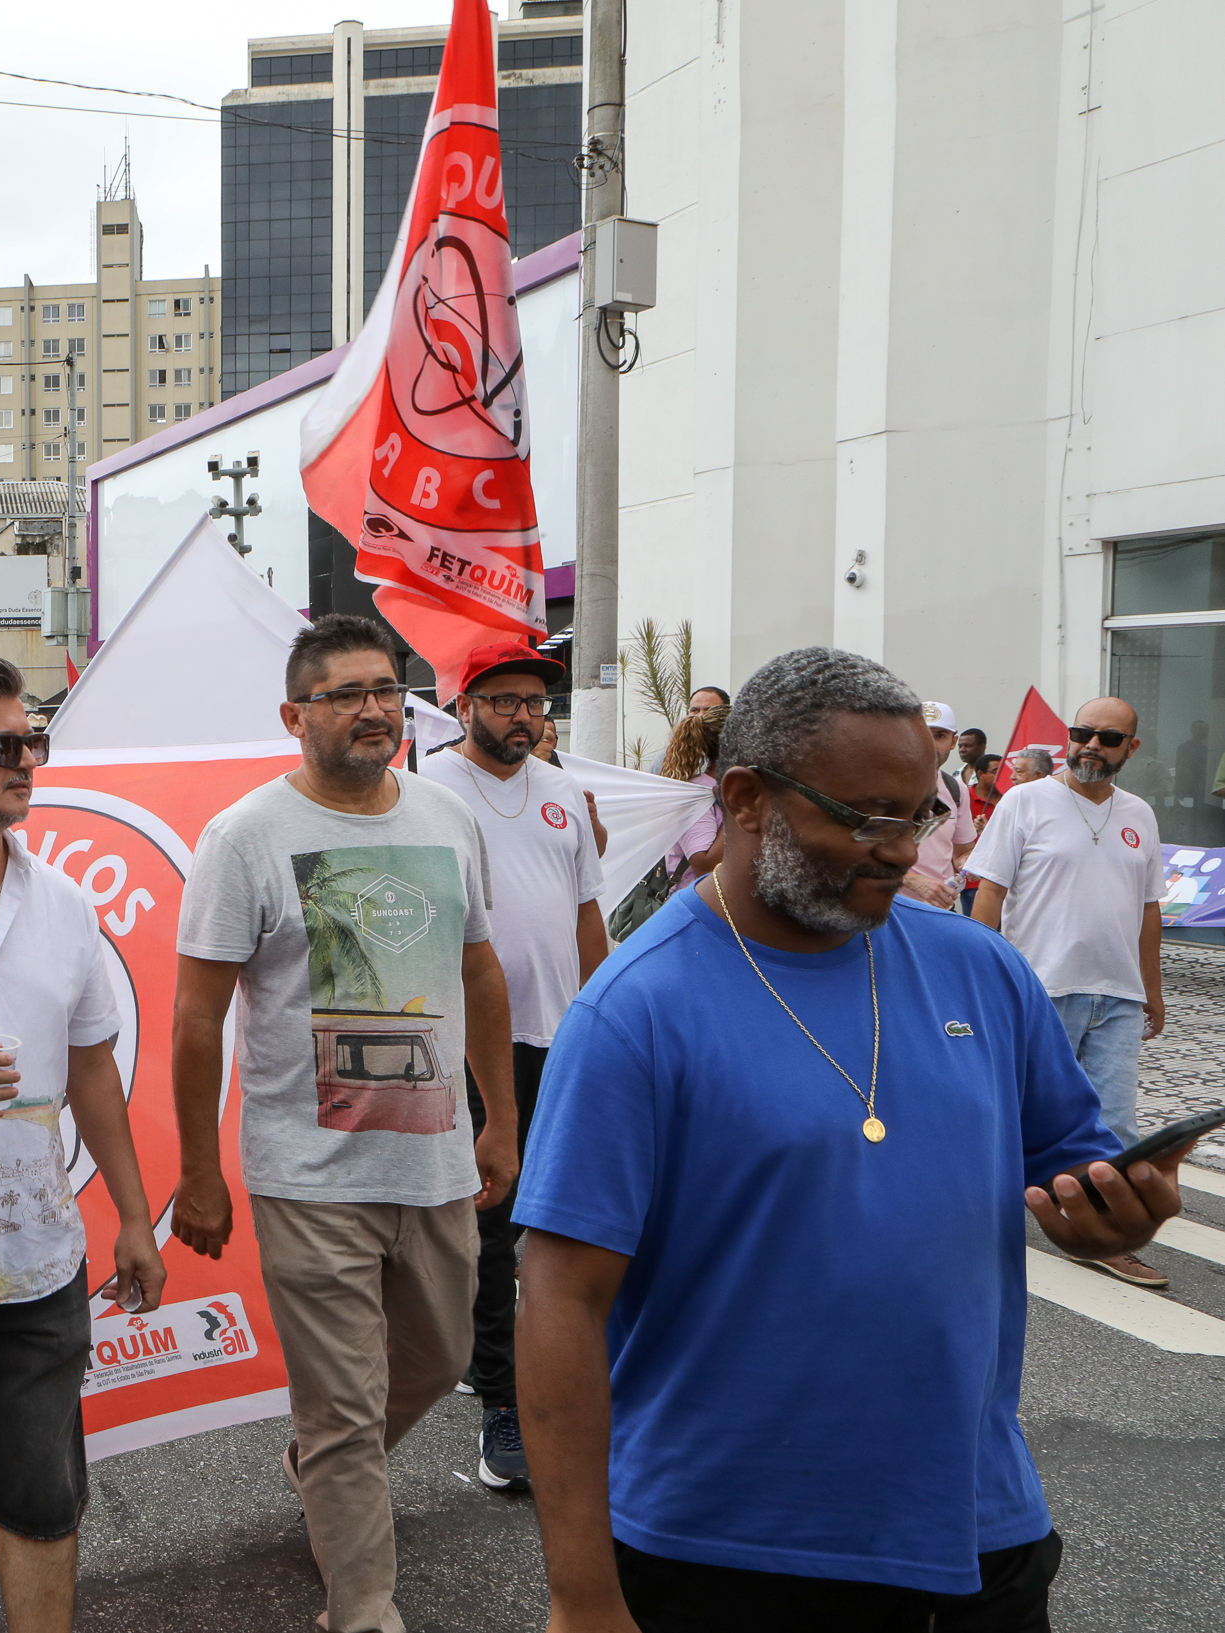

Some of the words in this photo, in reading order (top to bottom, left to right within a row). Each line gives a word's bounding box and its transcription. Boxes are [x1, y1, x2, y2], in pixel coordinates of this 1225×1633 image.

[441, 151, 506, 219] QU
[372, 908, 414, 917] SUNCOAST
[89, 1327, 178, 1369] QUIM
